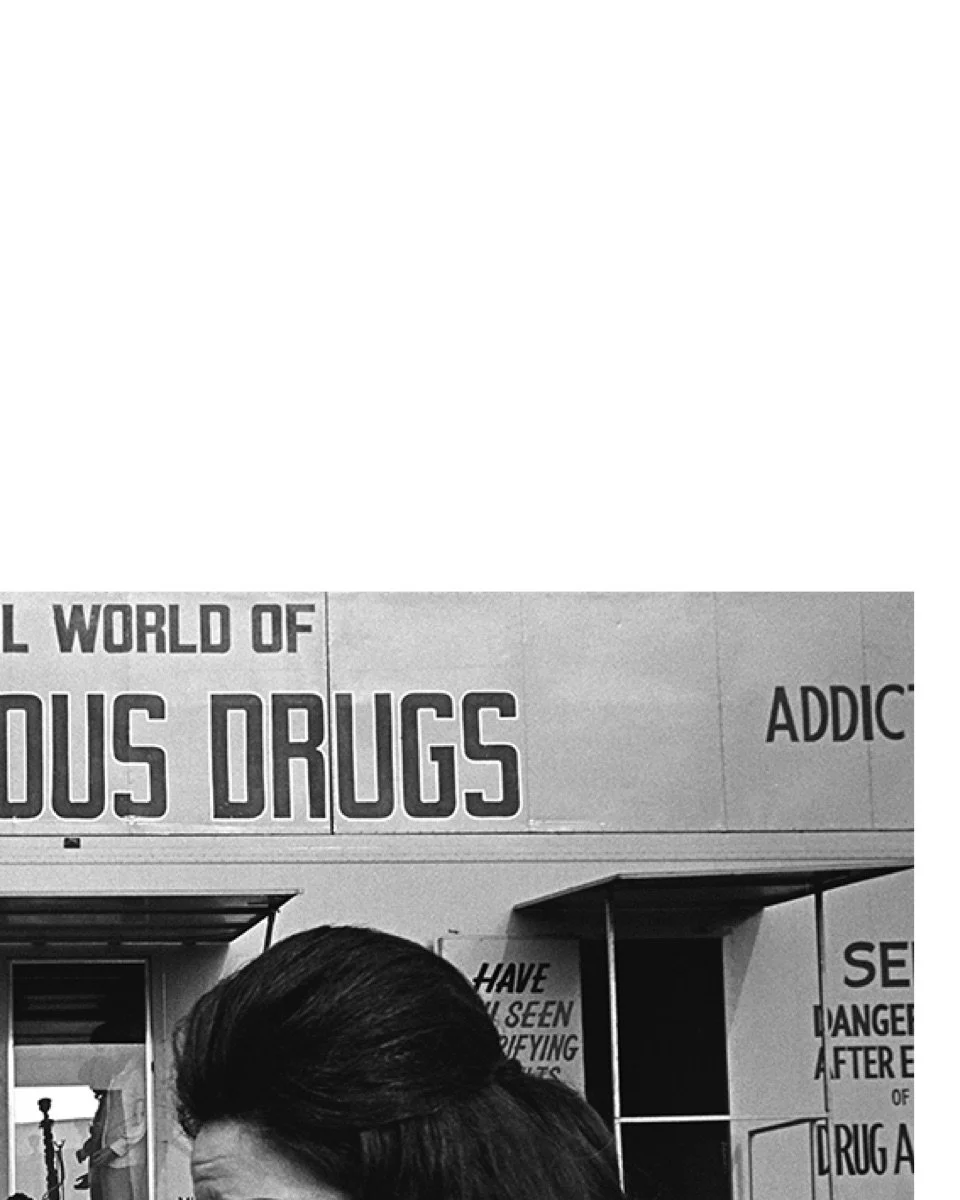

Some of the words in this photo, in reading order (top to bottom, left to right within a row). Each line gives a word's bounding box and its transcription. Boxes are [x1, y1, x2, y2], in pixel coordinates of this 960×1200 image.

[53, 603, 231, 654] WORLD
[251, 603, 316, 654] OF
[765, 683, 914, 743] ADDIC
[210, 691, 521, 821] DRUGS
[473, 962, 550, 994] HAVE
[843, 941, 914, 988] SE
[505, 1000, 574, 1028] SEEN
[814, 1045, 894, 1080] AFTER
[892, 1088, 910, 1106] OF
[817, 1123, 888, 1176] DRUG
